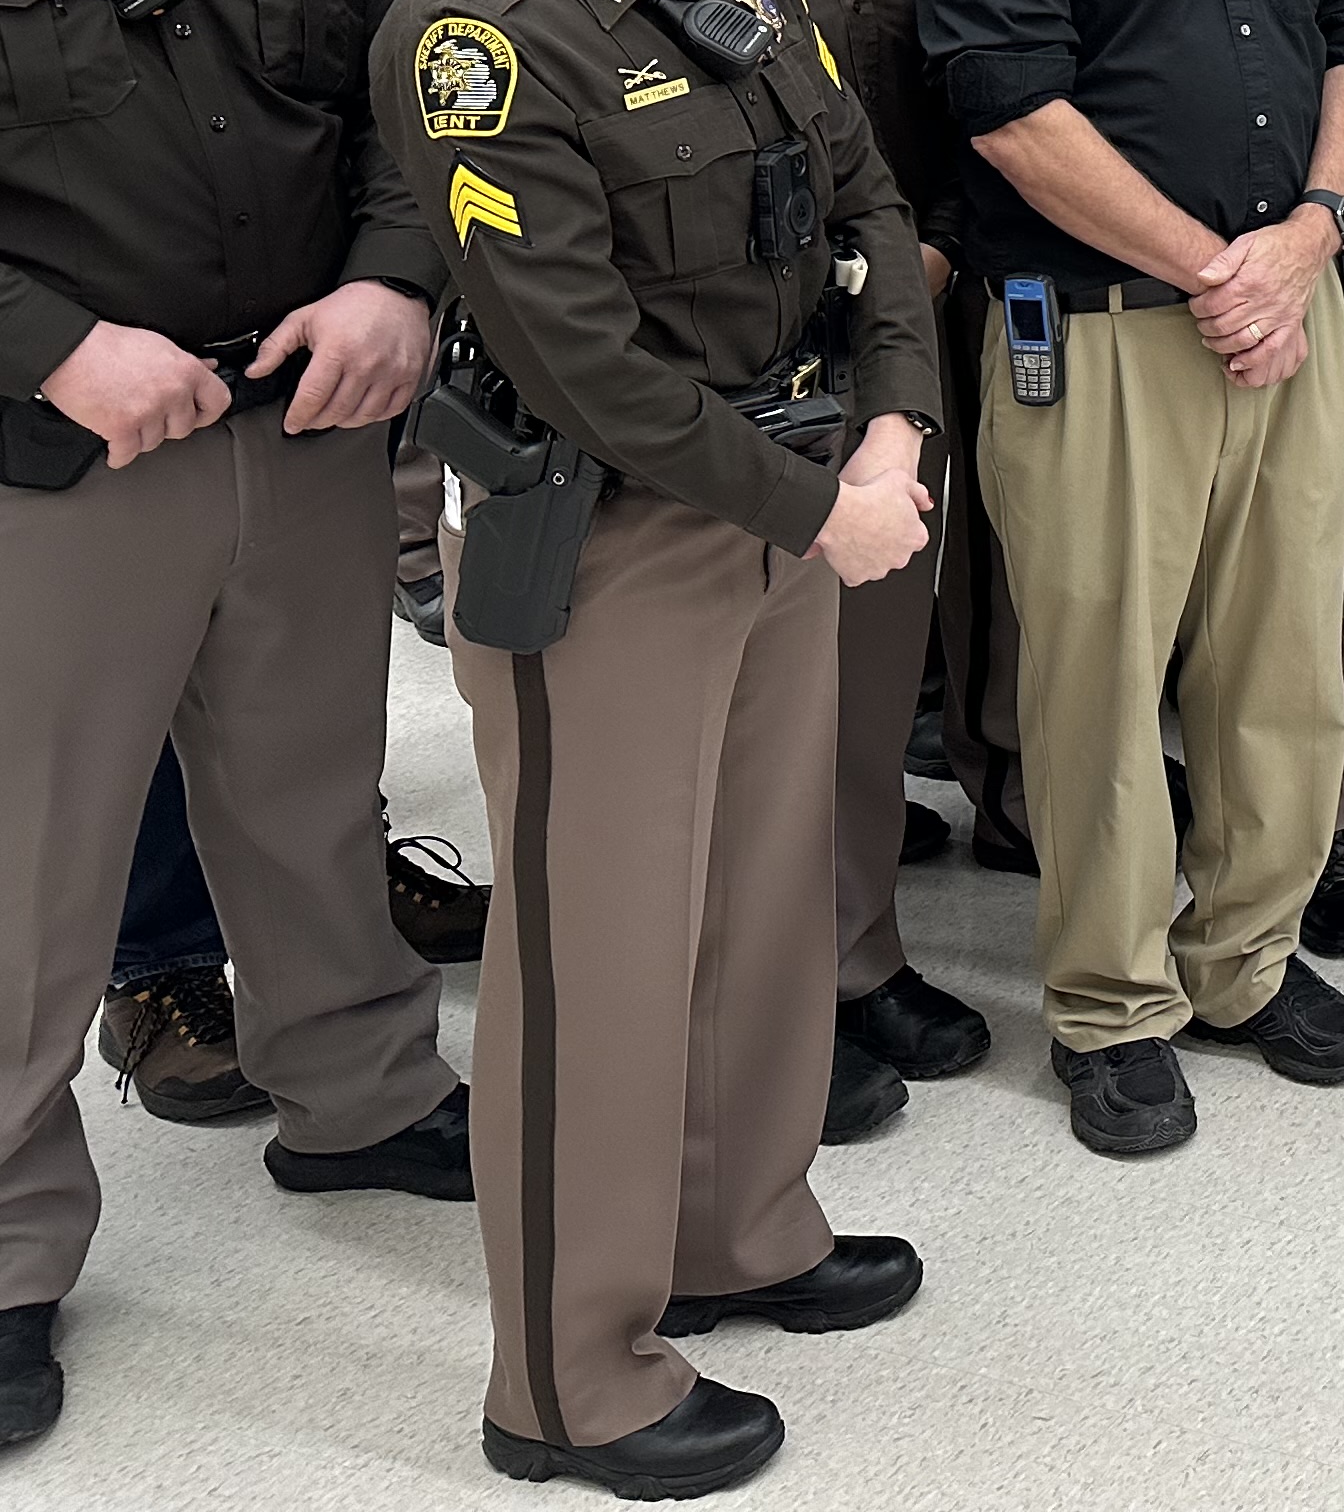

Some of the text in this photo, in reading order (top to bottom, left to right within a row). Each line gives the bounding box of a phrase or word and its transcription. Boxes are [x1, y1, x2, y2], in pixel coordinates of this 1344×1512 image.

[419, 23, 510, 71] SHERIFF DEPARTMENT
[629, 83, 685, 106] MATTHEWS
